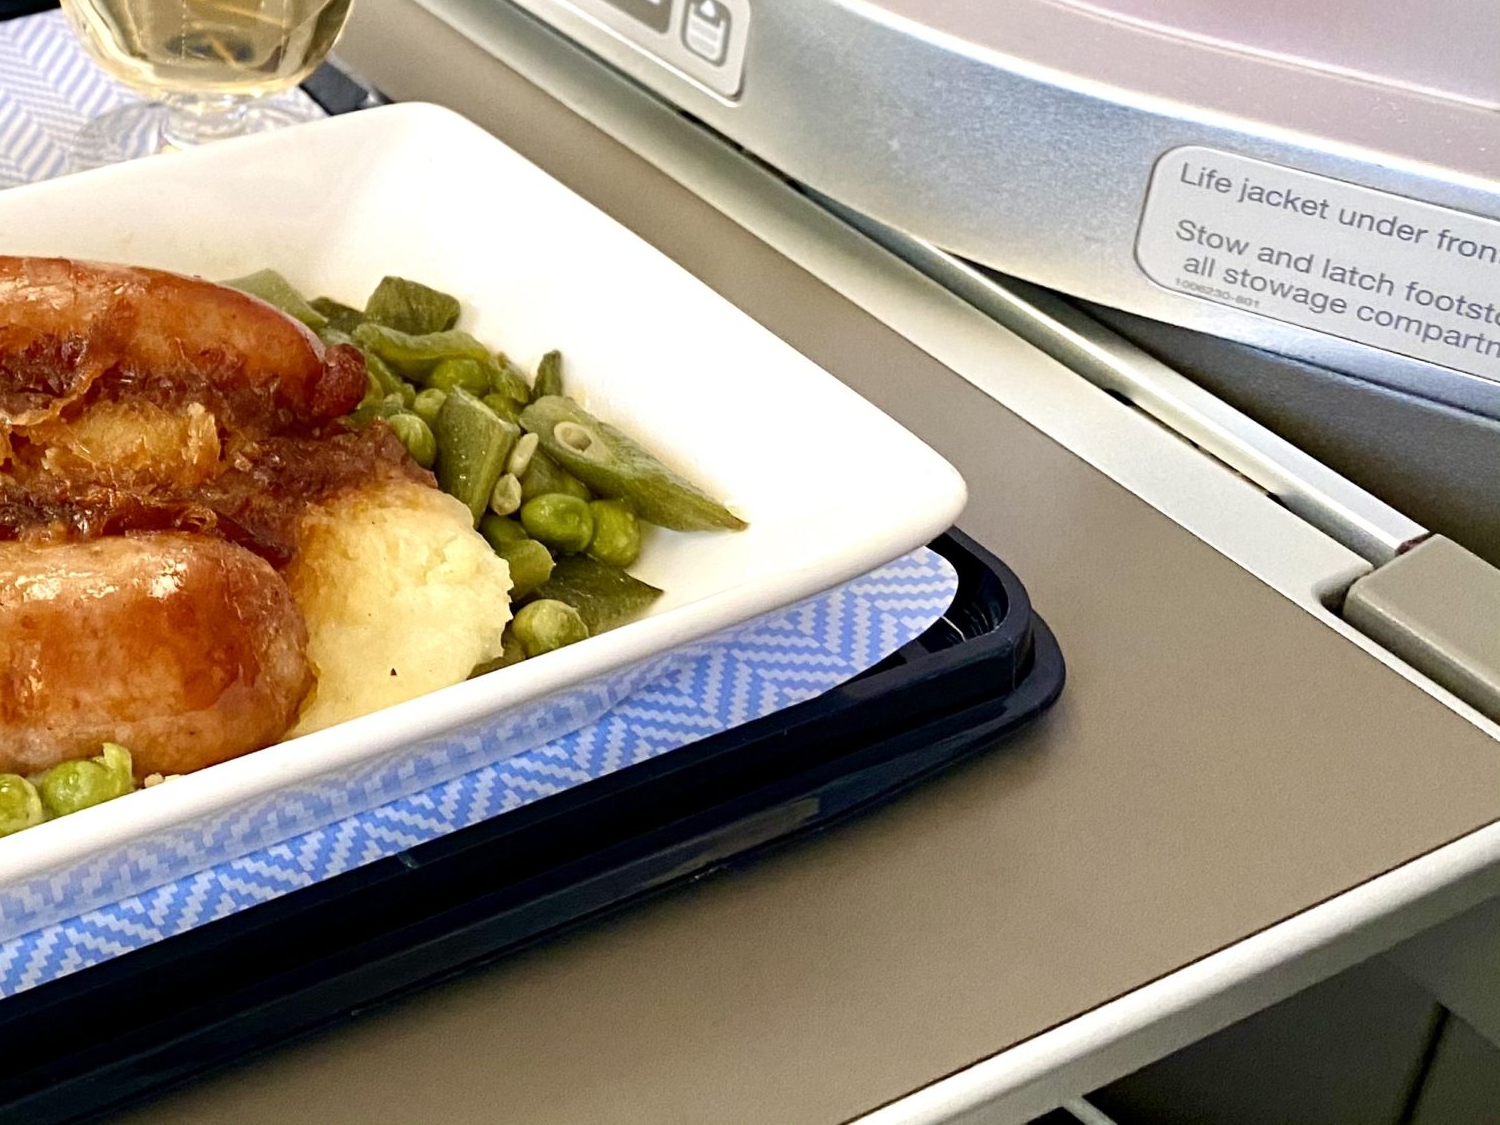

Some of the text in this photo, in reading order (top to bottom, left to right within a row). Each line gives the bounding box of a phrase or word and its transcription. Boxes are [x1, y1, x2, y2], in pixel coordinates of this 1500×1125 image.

[1180, 162, 1500, 264] Life jacket under fron
[1175, 219, 1249, 255] Stow
[1257, 245, 1314, 274] and
[1322, 258, 1395, 297] latch
[1183, 256, 1216, 278] all
[1222, 266, 1348, 314] stowage
